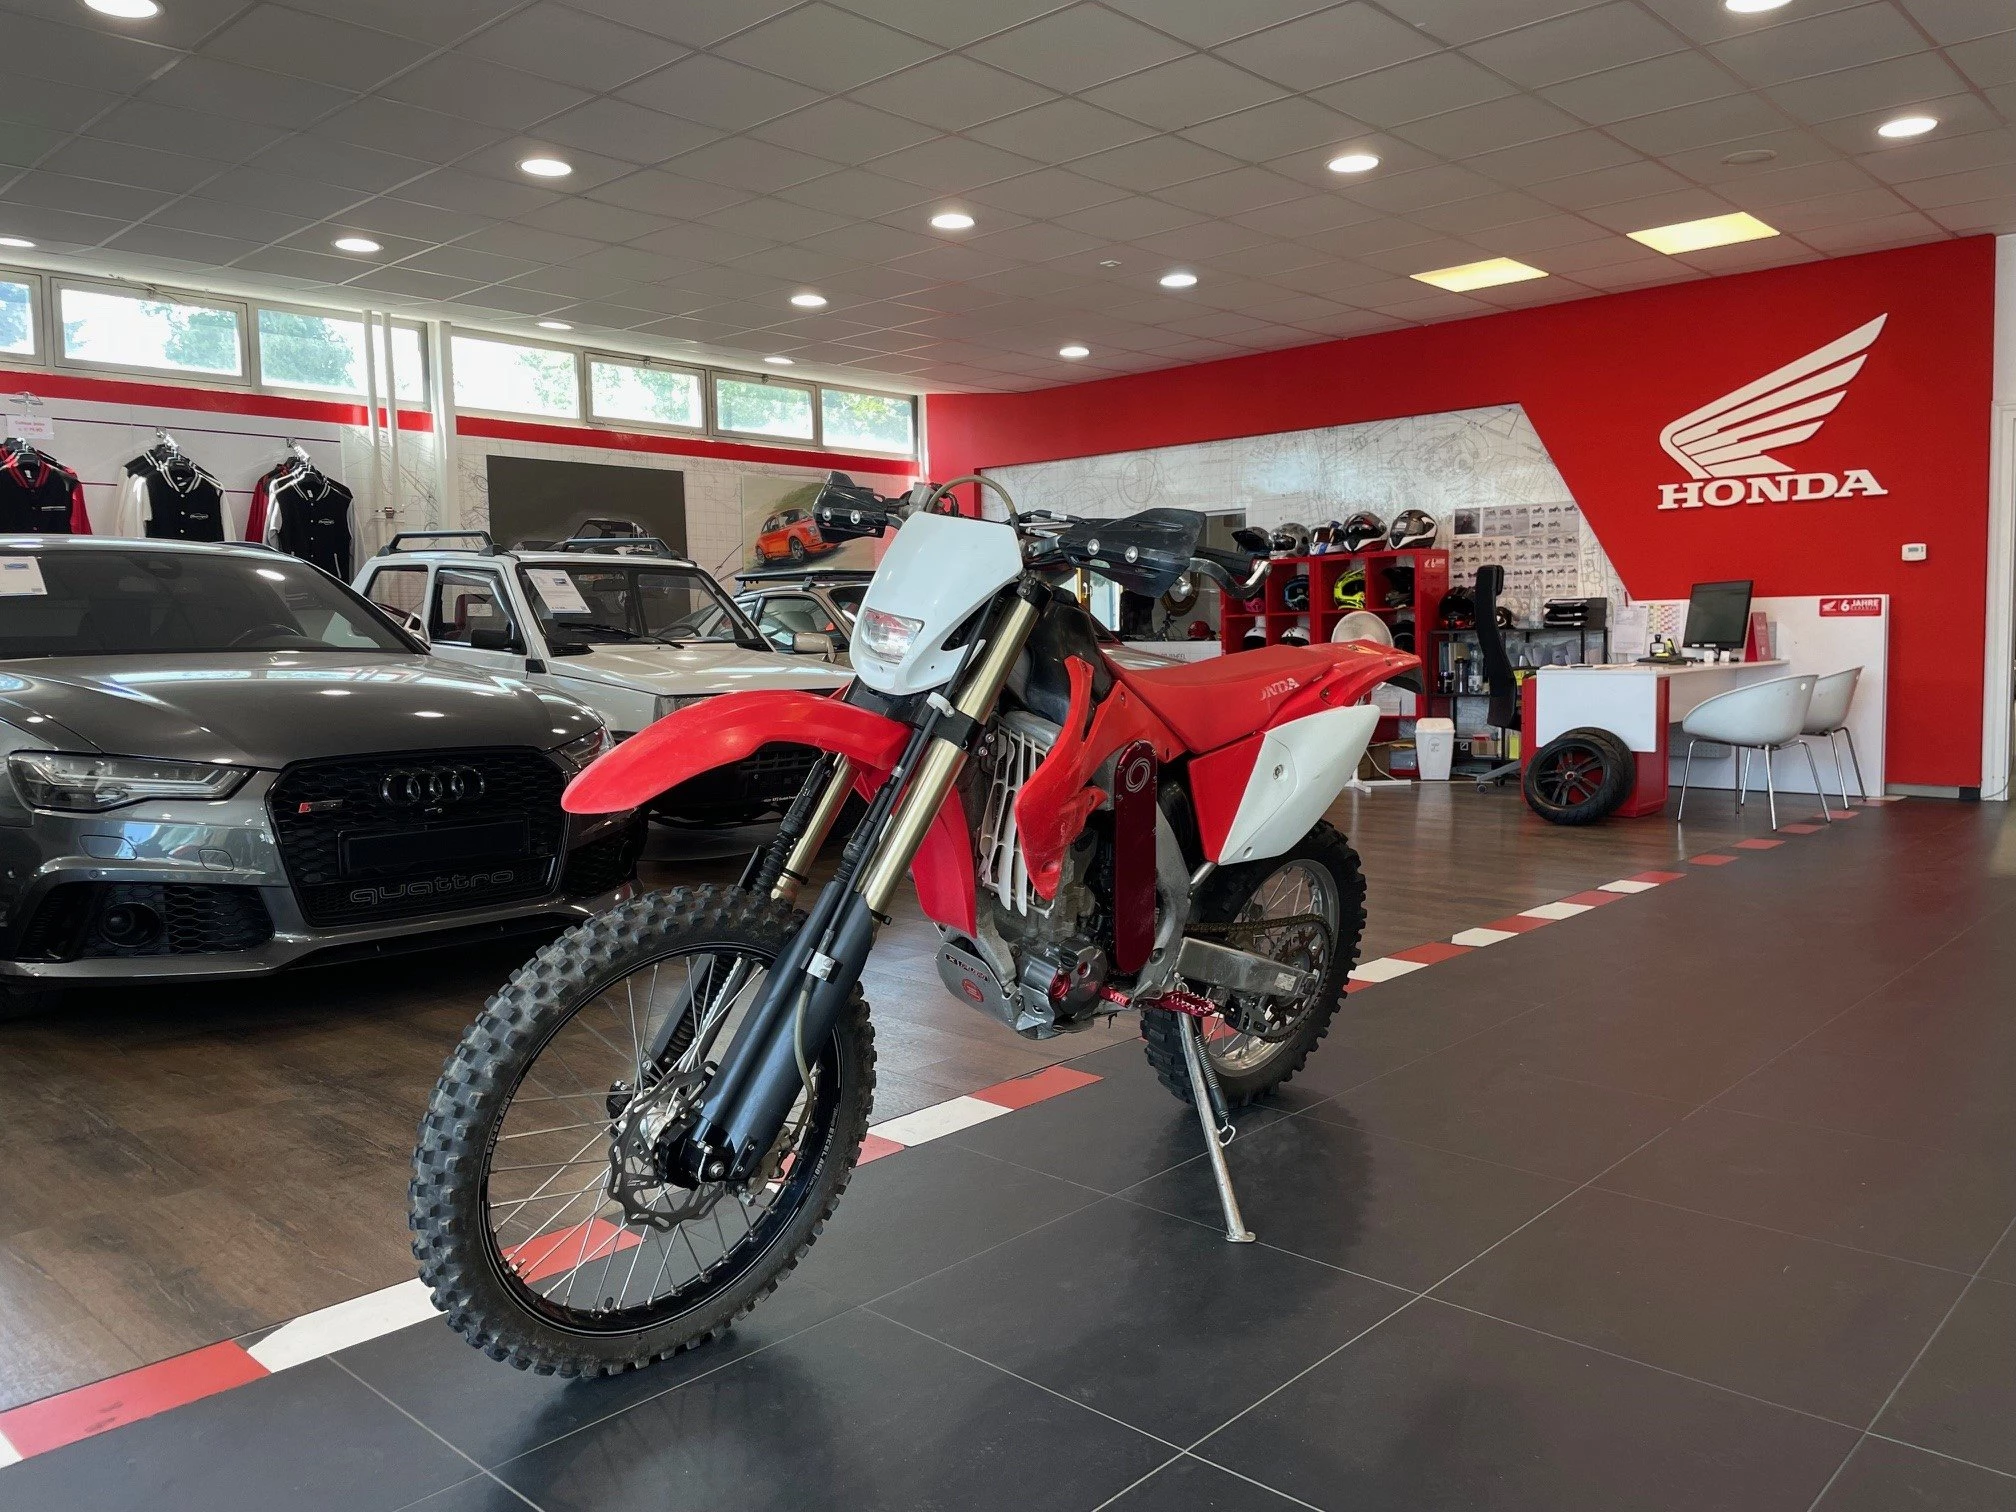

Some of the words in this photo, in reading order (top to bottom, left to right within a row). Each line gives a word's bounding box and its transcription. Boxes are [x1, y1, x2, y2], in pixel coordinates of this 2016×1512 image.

[1657, 469, 1888, 509] HONDA
[1840, 600, 1850, 612] 6
[350, 870, 514, 905] quattro
[821, 1127, 835, 1157] EXCEL
